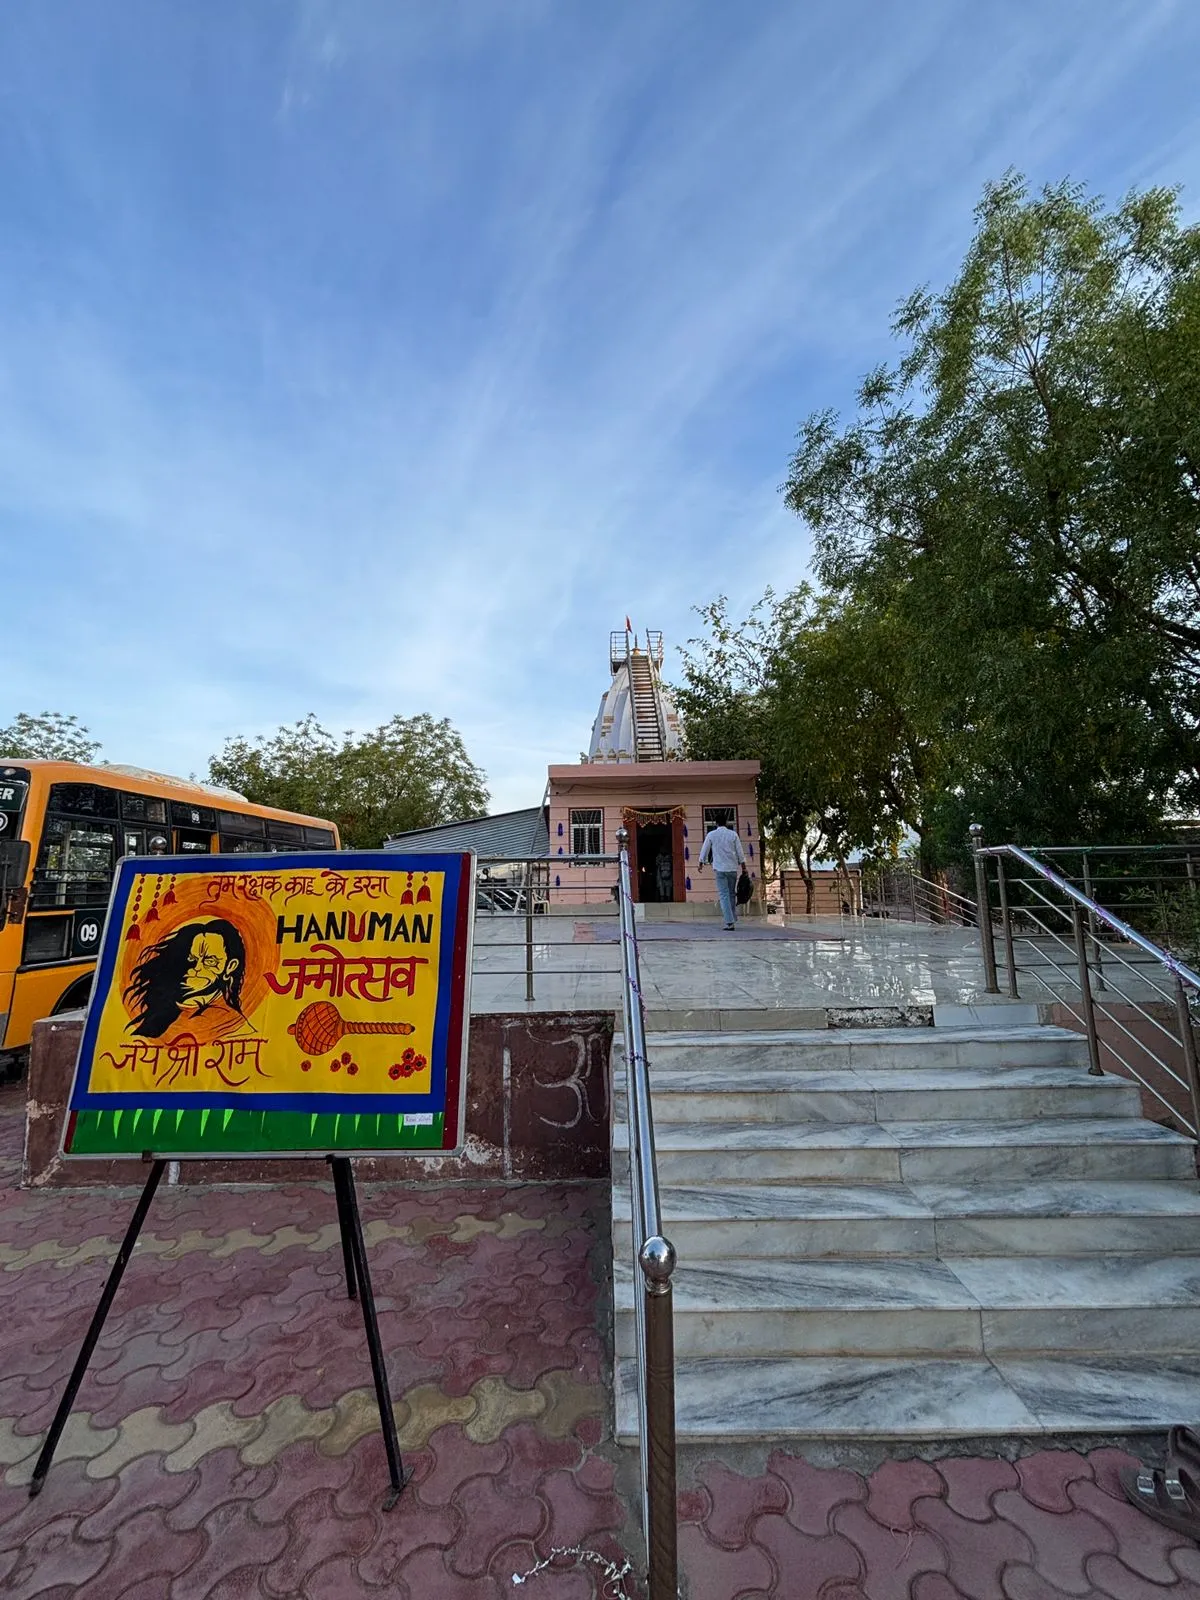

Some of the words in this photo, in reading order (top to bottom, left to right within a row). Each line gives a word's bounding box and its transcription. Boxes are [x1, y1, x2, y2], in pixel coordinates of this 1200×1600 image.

[199, 875, 240, 910] तुम
[237, 875, 282, 902] रक्षक
[80, 923, 98, 942] 09
[276, 910, 433, 944] HANUMAN
[263, 943, 429, 1002] जन्मोत्सव
[99, 1039, 164, 1075] जय
[156, 1032, 206, 1087] श्री
[204, 1039, 273, 1086] राम
